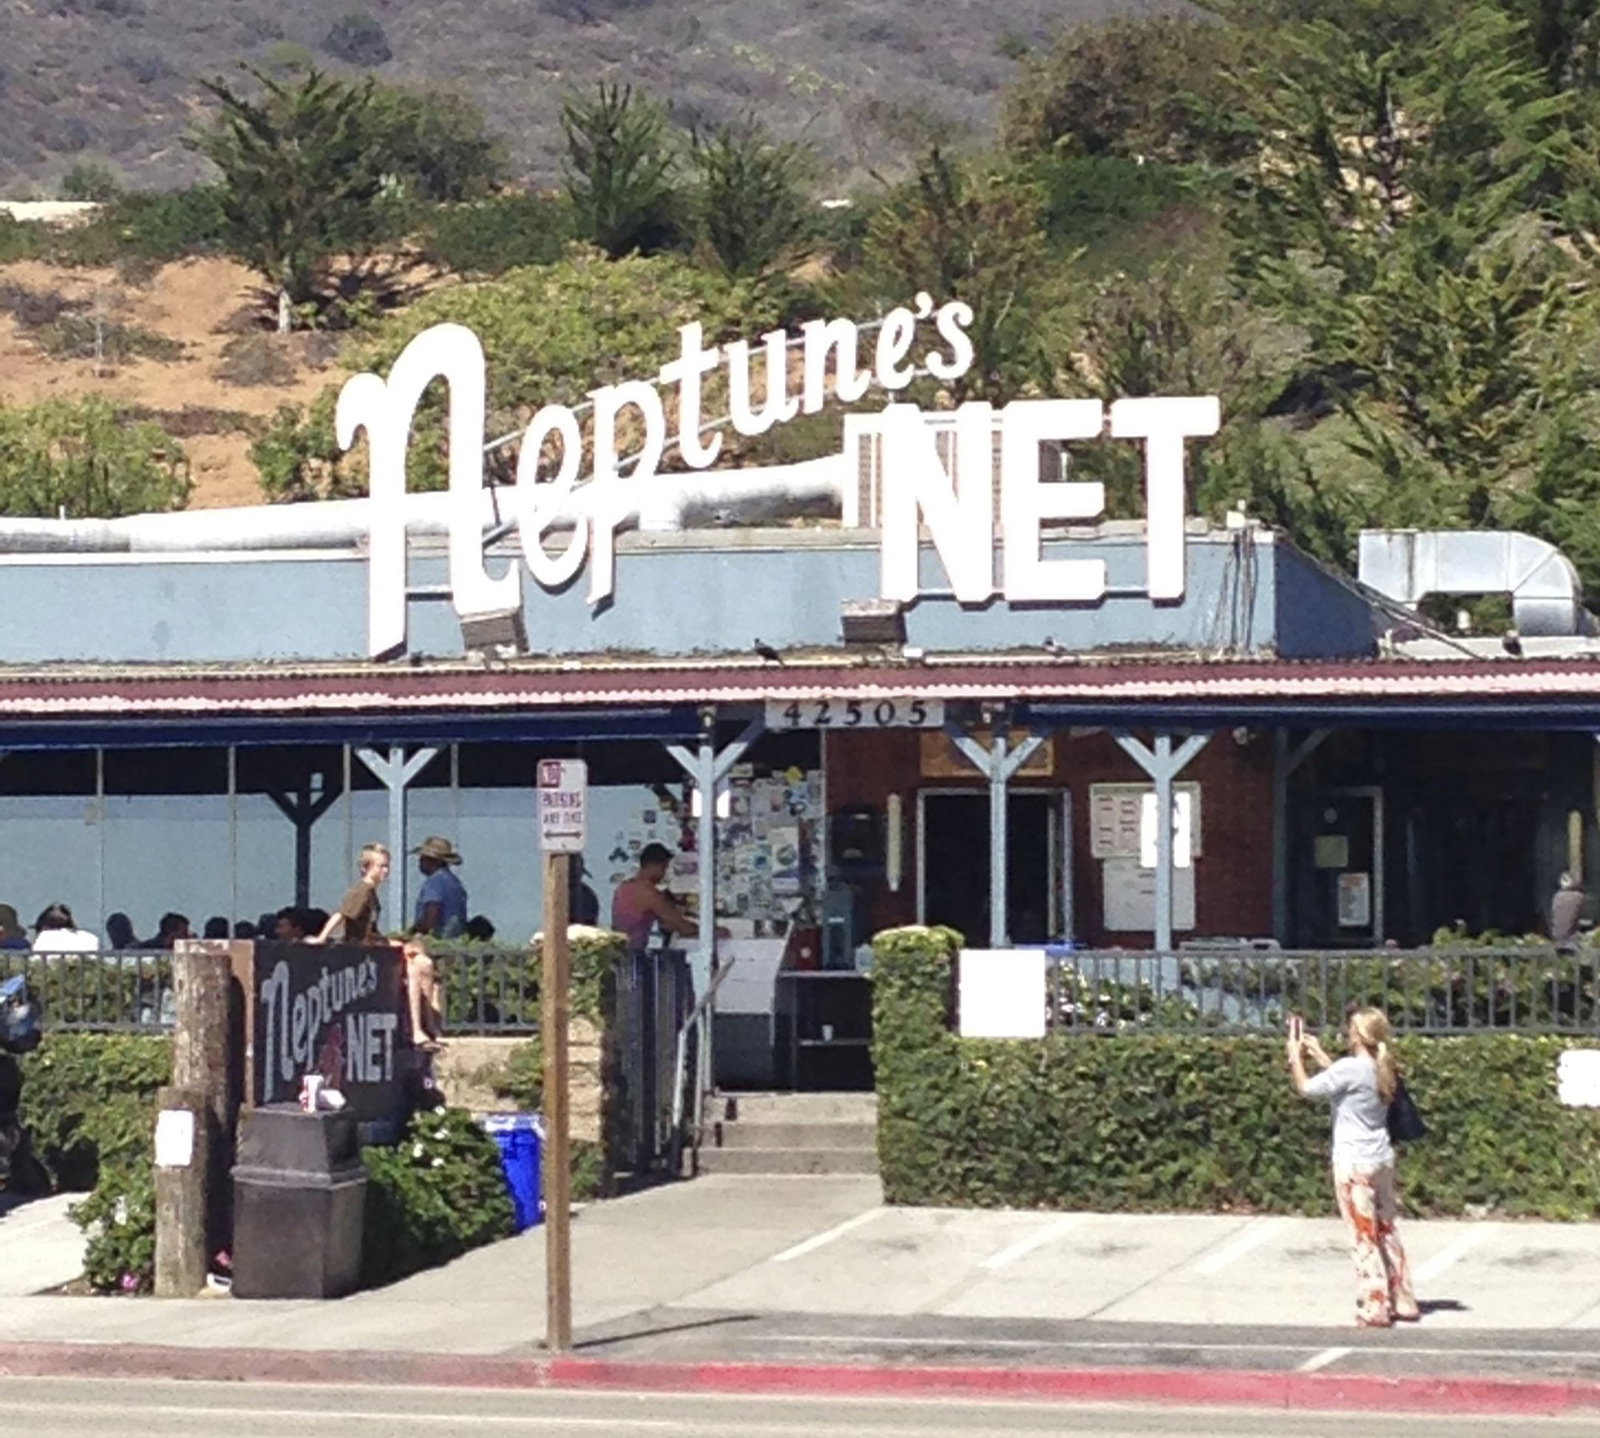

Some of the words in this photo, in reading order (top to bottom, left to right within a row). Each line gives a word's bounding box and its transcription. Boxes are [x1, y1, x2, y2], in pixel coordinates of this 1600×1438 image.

[336, 293, 974, 657] Neptune's
[877, 396, 1220, 603] NET
[784, 700, 927, 727] 42505
[346, 1013, 398, 1082] NET
